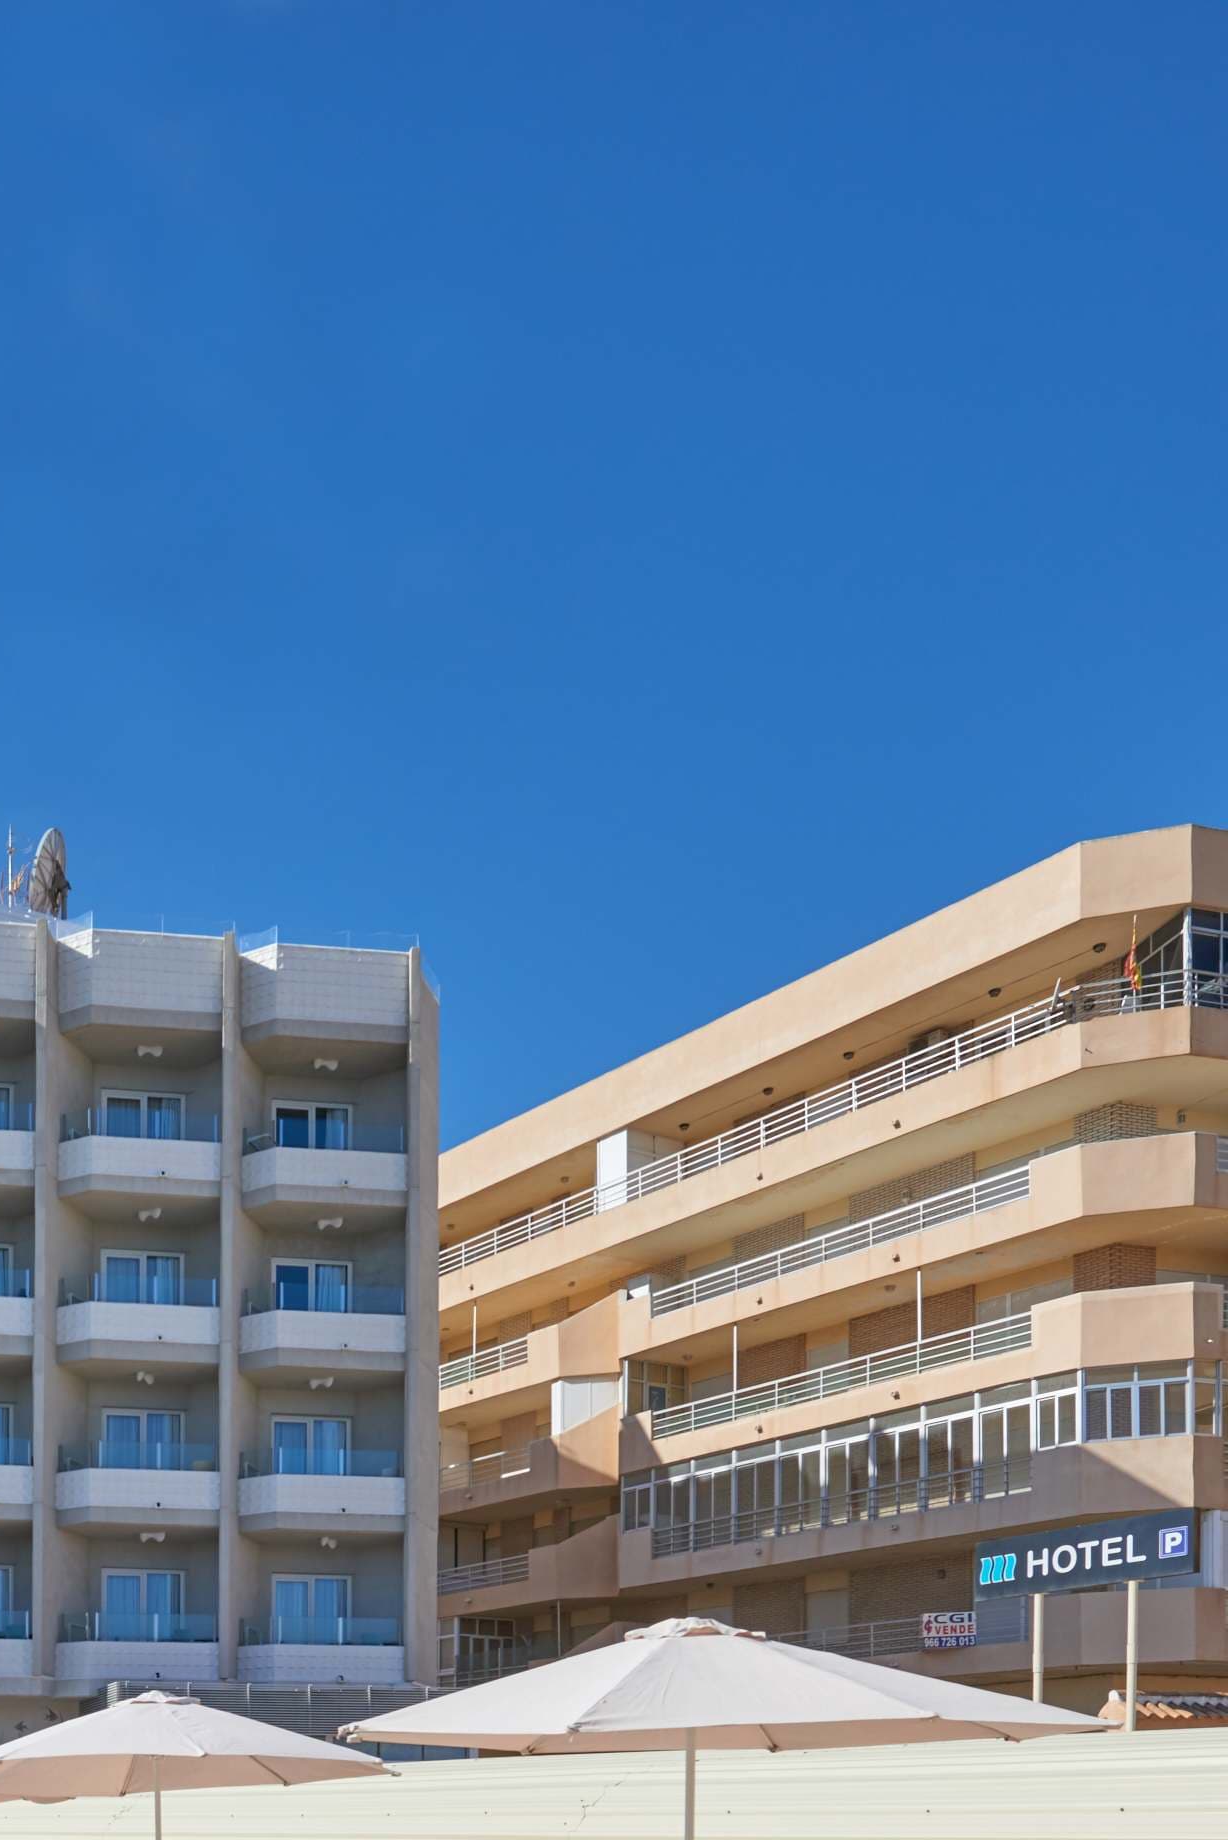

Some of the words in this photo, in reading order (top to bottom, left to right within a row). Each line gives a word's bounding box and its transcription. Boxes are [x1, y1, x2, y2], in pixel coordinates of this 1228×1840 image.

[1164, 1531, 1183, 1554] P
[1026, 1534, 1147, 1578] HOTEL
[934, 1613, 972, 1623] CGI
[935, 1624, 974, 1634] VENDE
